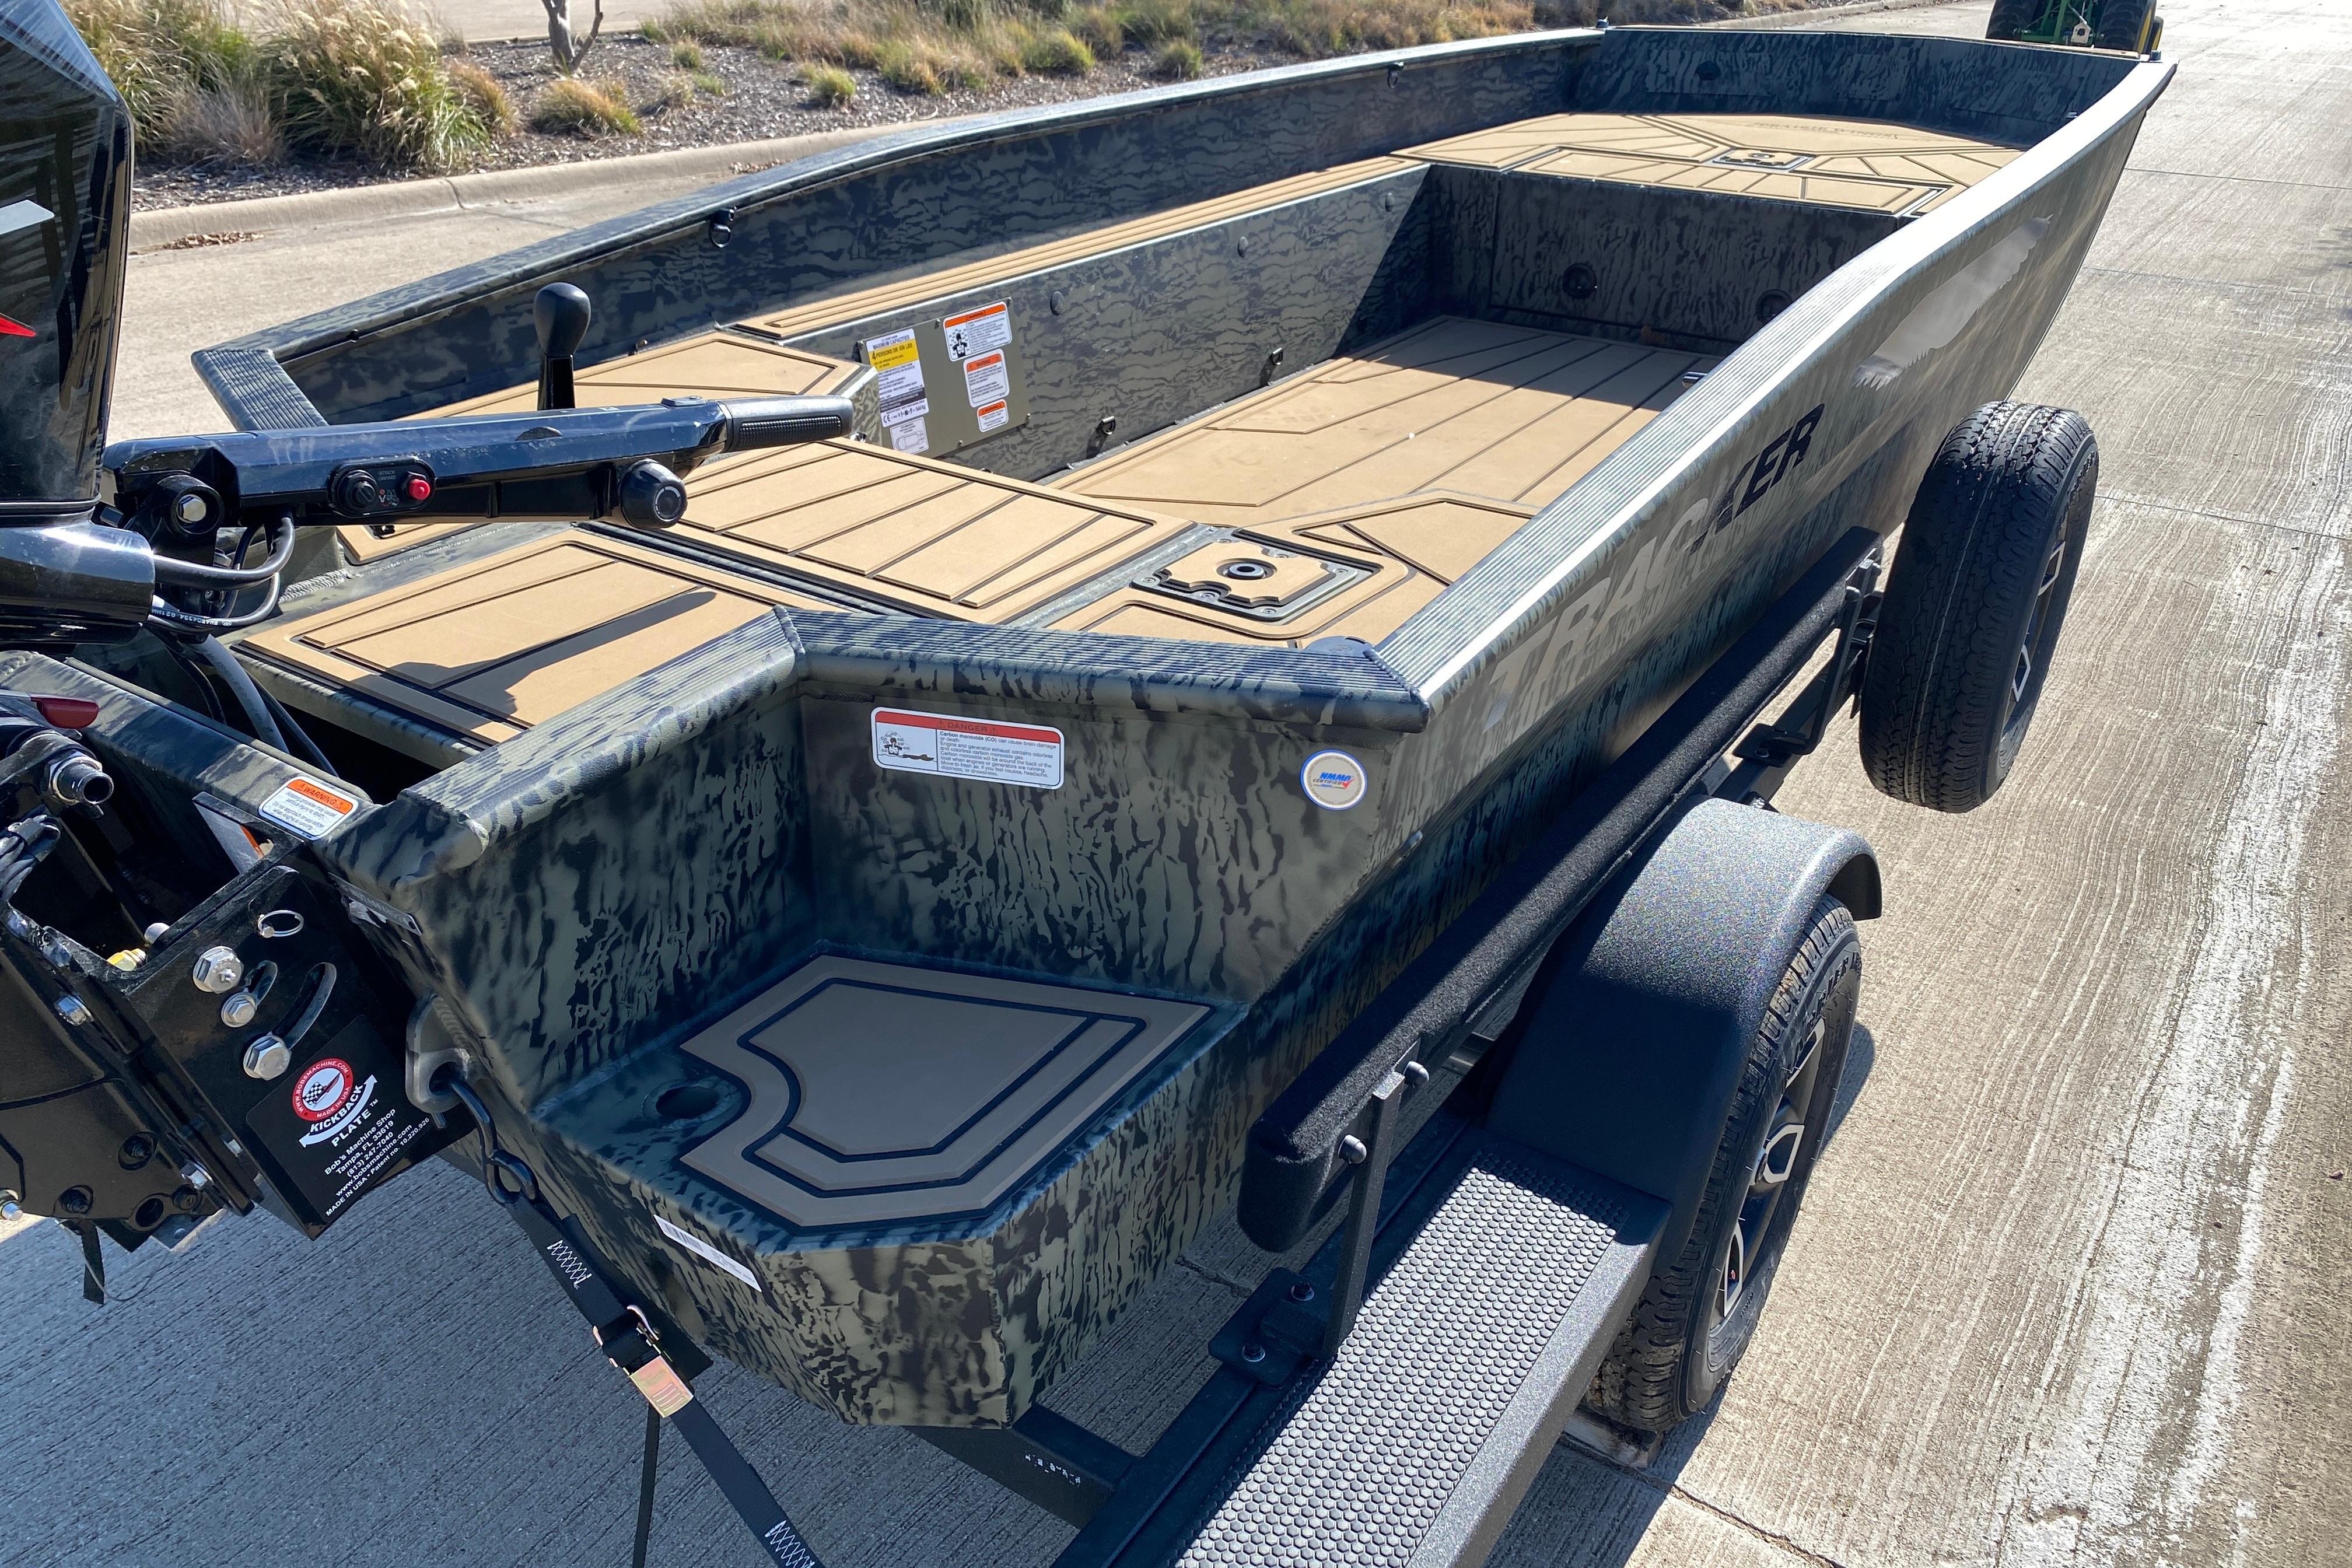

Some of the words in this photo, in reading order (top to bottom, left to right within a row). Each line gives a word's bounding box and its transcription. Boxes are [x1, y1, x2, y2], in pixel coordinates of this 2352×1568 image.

[947, 721, 988, 733] DANGER
[302, 786, 337, 806] WARNING
[295, 1060, 349, 1114] WWW.BOBSMACHINE.COM
[310, 1085, 363, 1133] KICKBACK
[316, 1107, 335, 1118] MADE
[336, 1100, 342, 1110] IN
[341, 1086, 351, 1101] USA
[324, 1155, 347, 1175] Bob's
[346, 1126, 377, 1155] Machine
[376, 1108, 396, 1128] Shop
[331, 1108, 372, 1147] PLATE
[335, 1151, 363, 1175] Tampa,
[362, 1140, 373, 1151] FL
[372, 1120, 394, 1142] 33619
[335, 1124, 412, 1196] www.bobsmachine.com
[346, 1158, 365, 1177] (813)
[364, 1131, 394, 1161] 247-7040
[326, 1196, 346, 1216] MADE
[345, 1189, 354, 1198] IN
[352, 1177, 368, 1191] USA
[370, 1154, 390, 1175] Patent
[390, 1147, 401, 1157] no.
